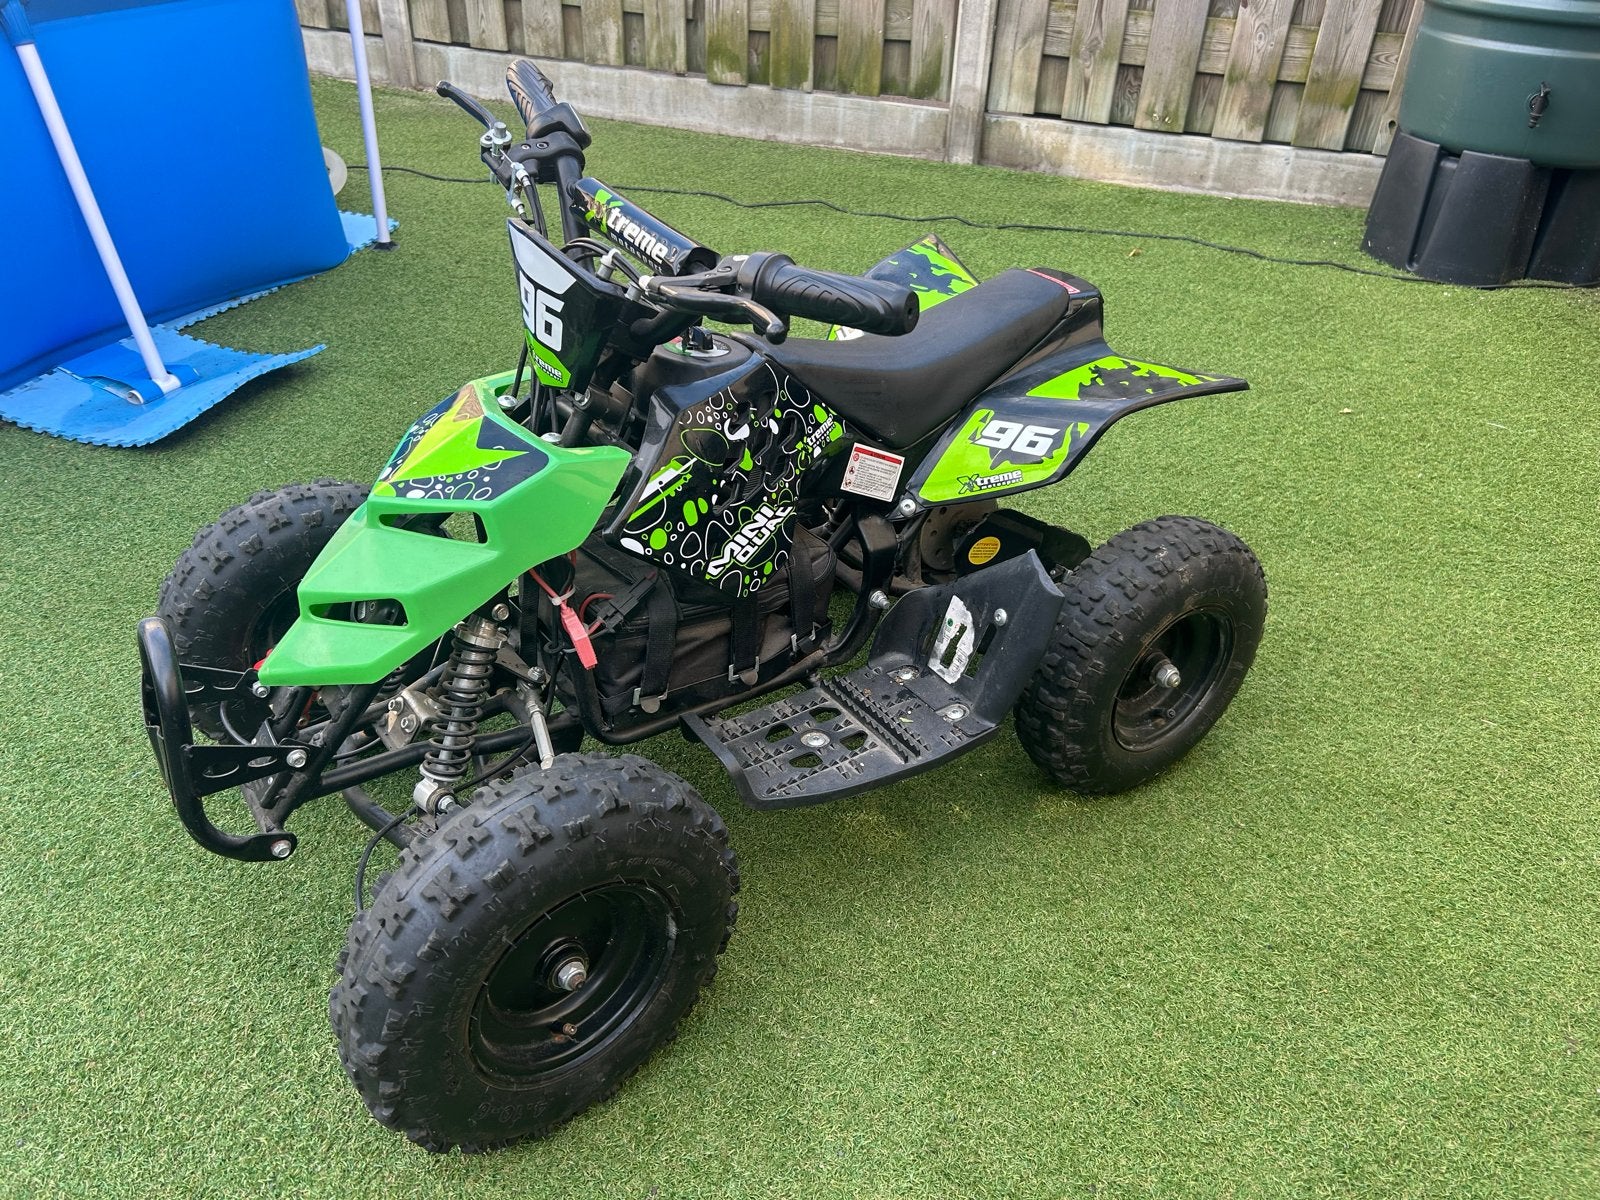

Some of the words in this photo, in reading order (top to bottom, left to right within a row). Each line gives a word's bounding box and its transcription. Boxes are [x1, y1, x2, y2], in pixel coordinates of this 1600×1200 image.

[584, 189, 669, 265] Xtreme
[519, 270, 565, 352] 96
[971, 419, 1060, 457] 96
[956, 469, 1022, 494] Xtreme
[707, 505, 775, 576] MINI
